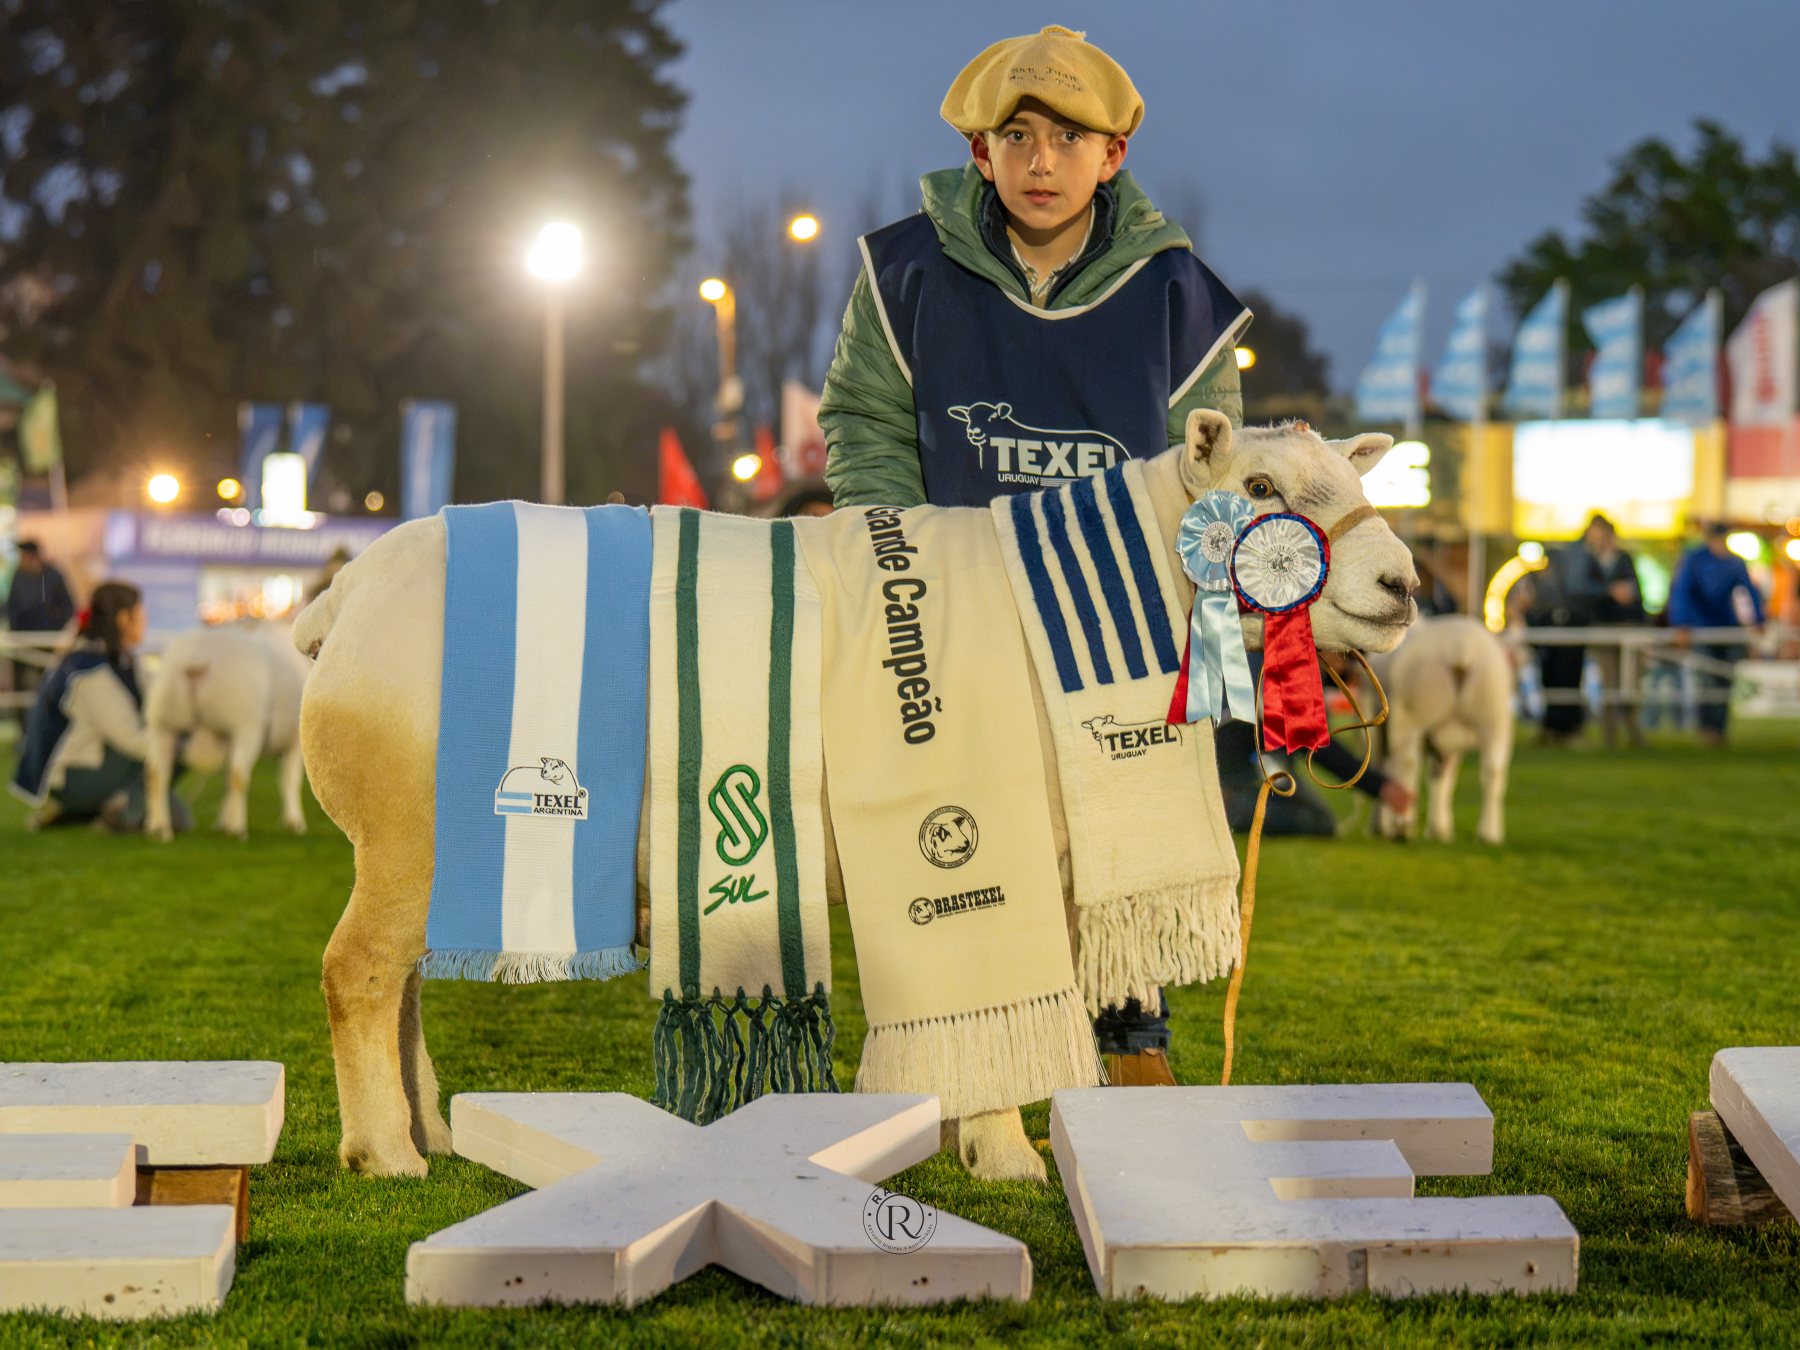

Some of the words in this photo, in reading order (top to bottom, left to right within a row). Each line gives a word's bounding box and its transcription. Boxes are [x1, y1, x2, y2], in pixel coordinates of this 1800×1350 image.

[997, 472, 1040, 486] URUGUAY
[882, 578, 943, 745] Campeão
[1104, 724, 1177, 752] TEXEL
[1110, 748, 1147, 761] URUGUAY
[533, 793, 582, 809] TEXEL
[533, 807, 583, 816] ARGENTINA
[703, 873, 770, 917] SUL
[933, 885, 1006, 915] BRASTEXEL
